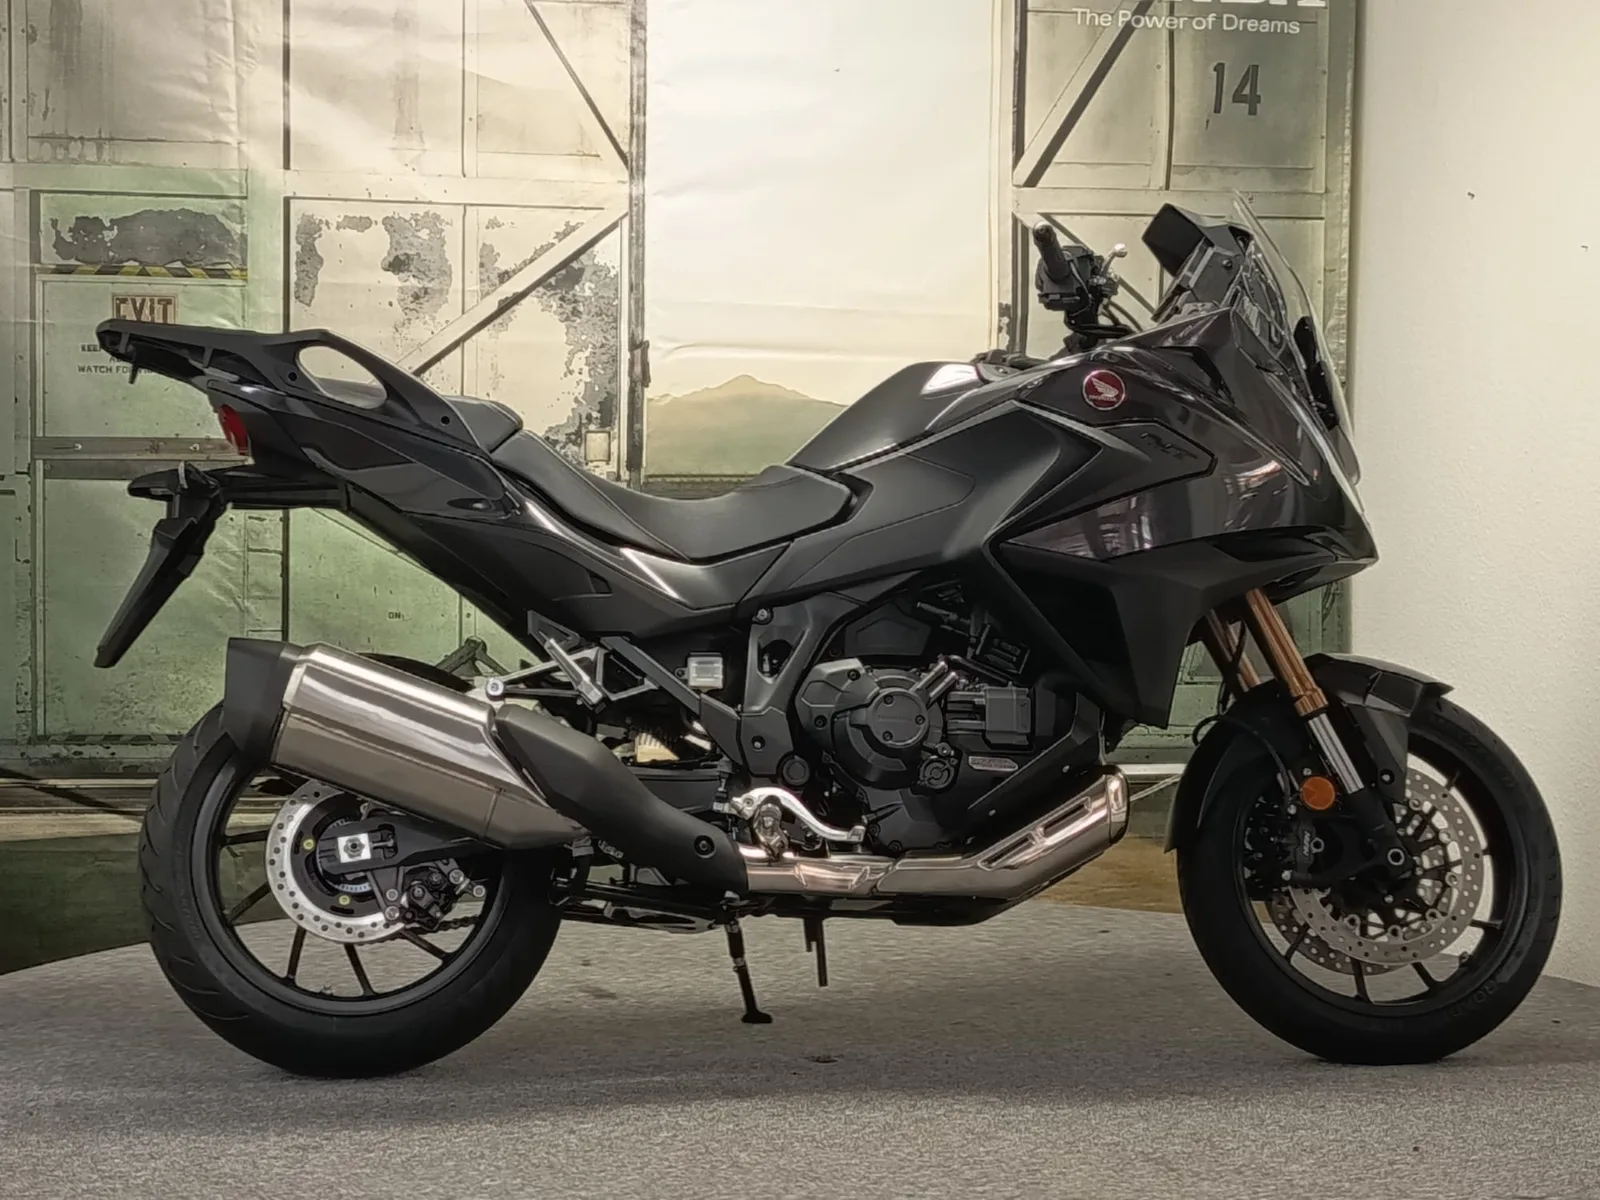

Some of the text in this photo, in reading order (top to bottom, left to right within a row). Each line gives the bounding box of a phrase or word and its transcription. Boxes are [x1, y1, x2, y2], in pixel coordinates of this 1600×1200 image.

[1071, 7, 1300, 34] The Power of Dreams
[1213, 62, 1261, 116] 14
[77, 365, 113, 374] WATCH
